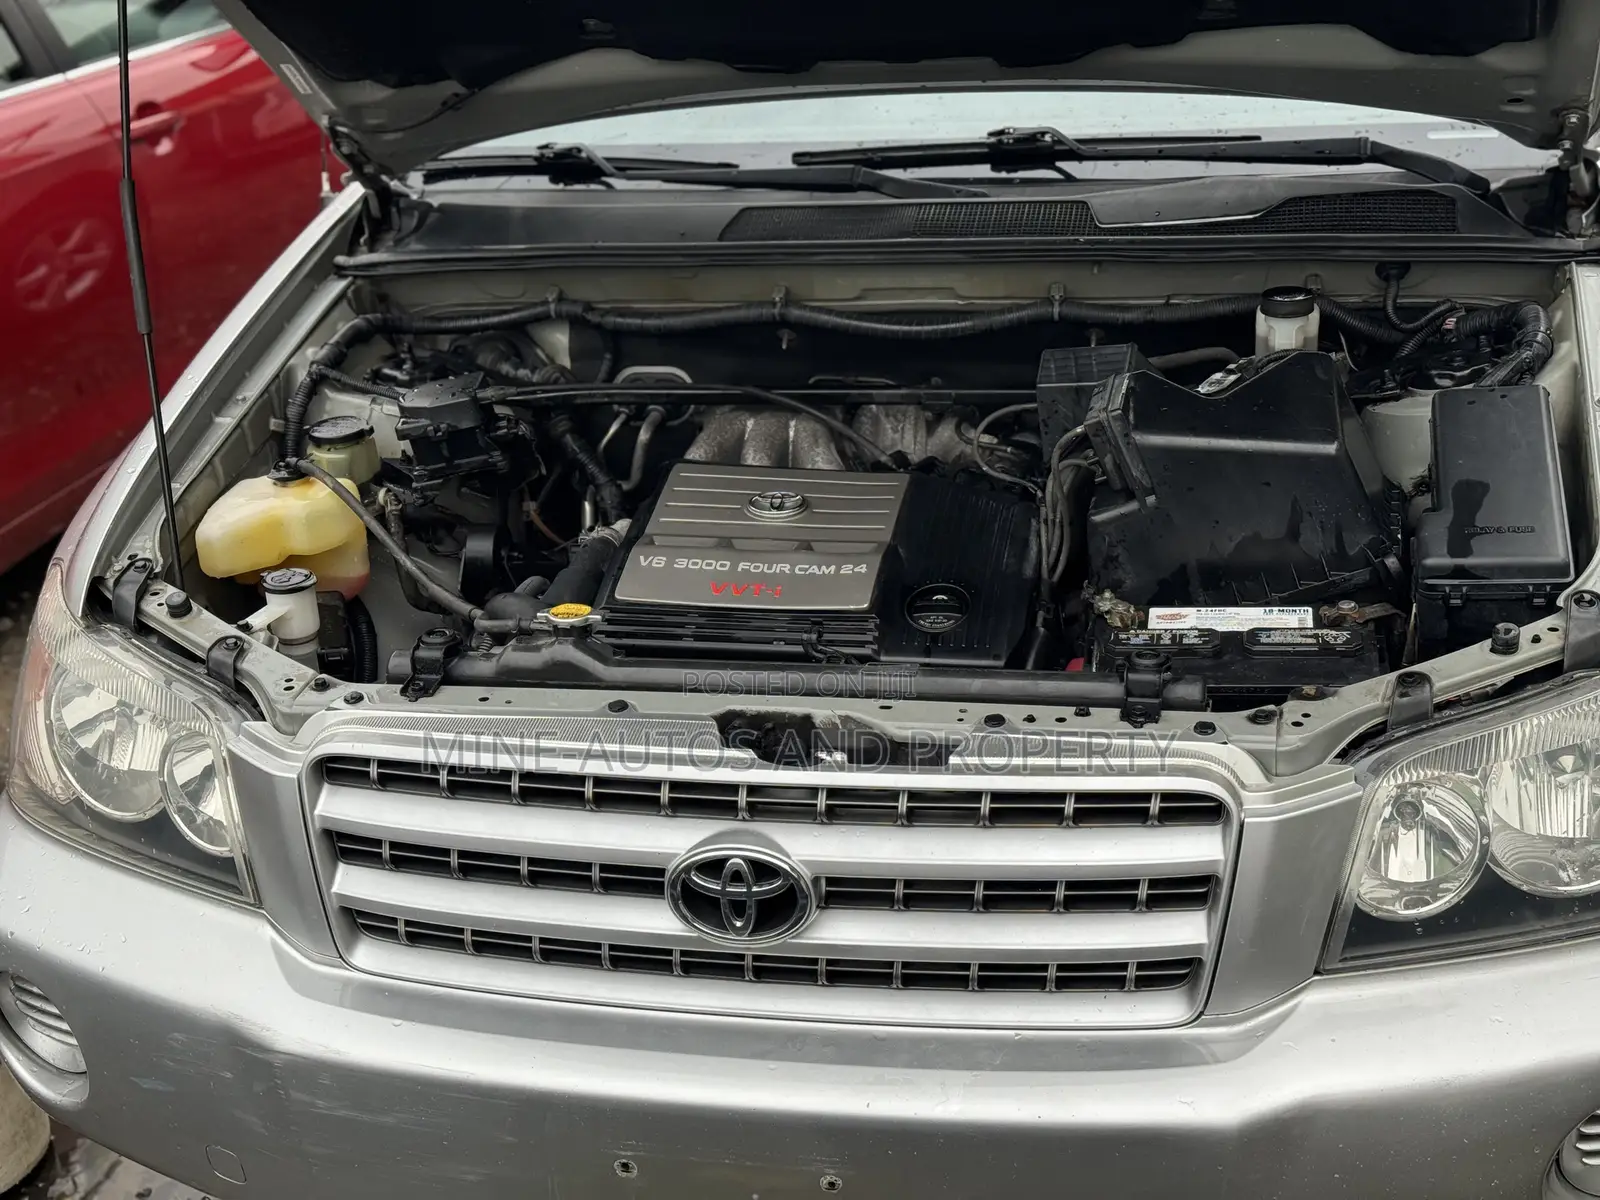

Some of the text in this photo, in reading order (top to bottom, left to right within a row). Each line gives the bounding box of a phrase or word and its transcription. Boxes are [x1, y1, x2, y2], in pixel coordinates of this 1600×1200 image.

[639, 555, 868, 575] V6 3000 FOUR CAM 24
